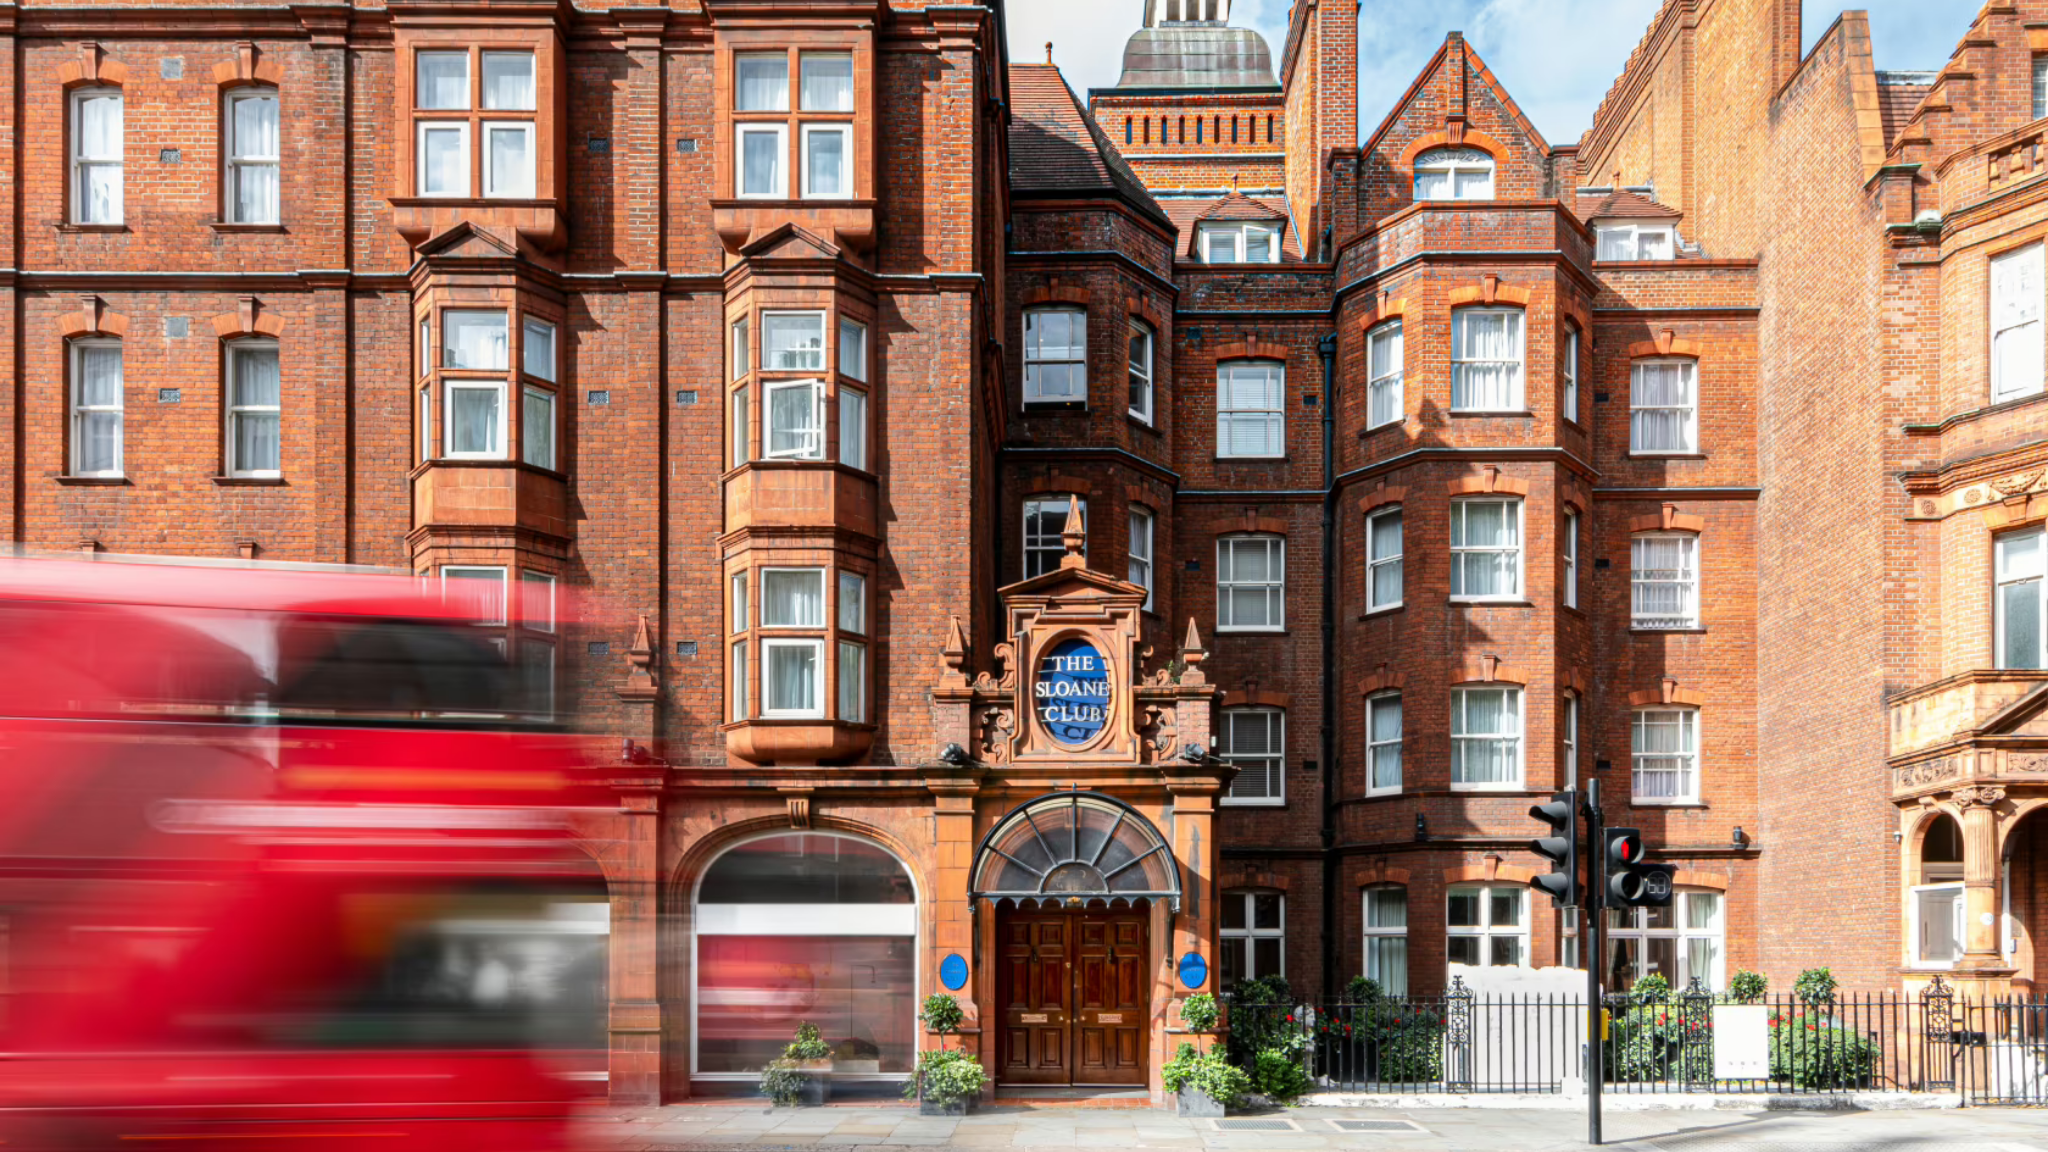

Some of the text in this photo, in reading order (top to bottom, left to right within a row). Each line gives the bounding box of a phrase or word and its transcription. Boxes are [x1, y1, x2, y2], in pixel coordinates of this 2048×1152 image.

[1052, 656, 1095, 671] THE
[1036, 681, 1111, 697] SLOANE
[1045, 706, 1102, 722] CLUB
